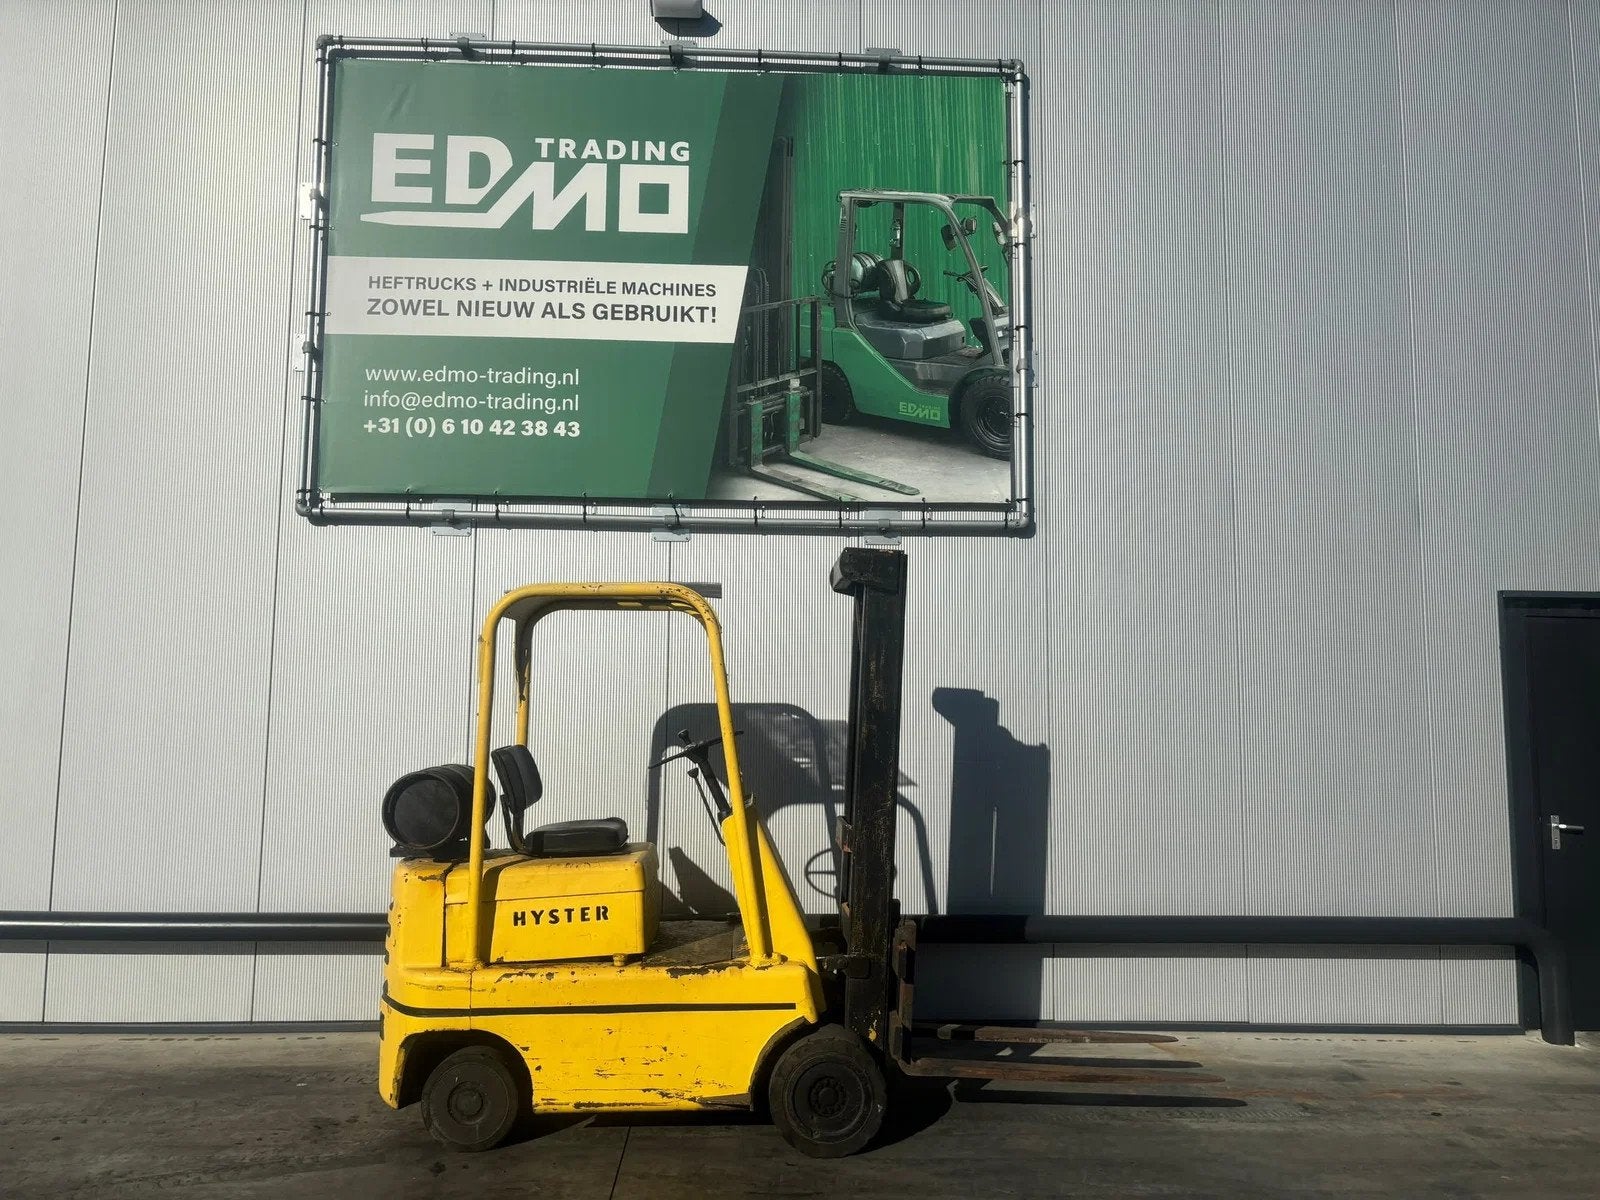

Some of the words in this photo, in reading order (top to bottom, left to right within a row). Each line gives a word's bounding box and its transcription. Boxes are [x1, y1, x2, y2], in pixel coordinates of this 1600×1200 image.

[534, 137, 690, 162] TRADING
[360, 132, 689, 234] EDMO
[368, 275, 477, 291] HEFTRUCKS
[482, 280, 493, 291] +
[499, 277, 617, 295] INDUSTRIËLE
[622, 281, 717, 297] MACHINES
[366, 298, 450, 316] ZOWEL
[456, 299, 535, 318] NIEUW
[540, 301, 586, 320] ALS
[592, 303, 717, 323] GEBRUIKT!
[365, 366, 580, 389] www.edmo-trading.nl
[364, 390, 580, 415] info@edmo-trading.nl
[898, 401, 941, 421] EDMO
[363, 418, 399, 434] +31
[405, 416, 436, 437] (0)
[441, 419, 456, 435] 6
[460, 419, 484, 435] 10
[489, 420, 516, 436] 42
[520, 420, 548, 437] 38
[553, 421, 581, 437] 43
[513, 905, 609, 926] HYSTER
